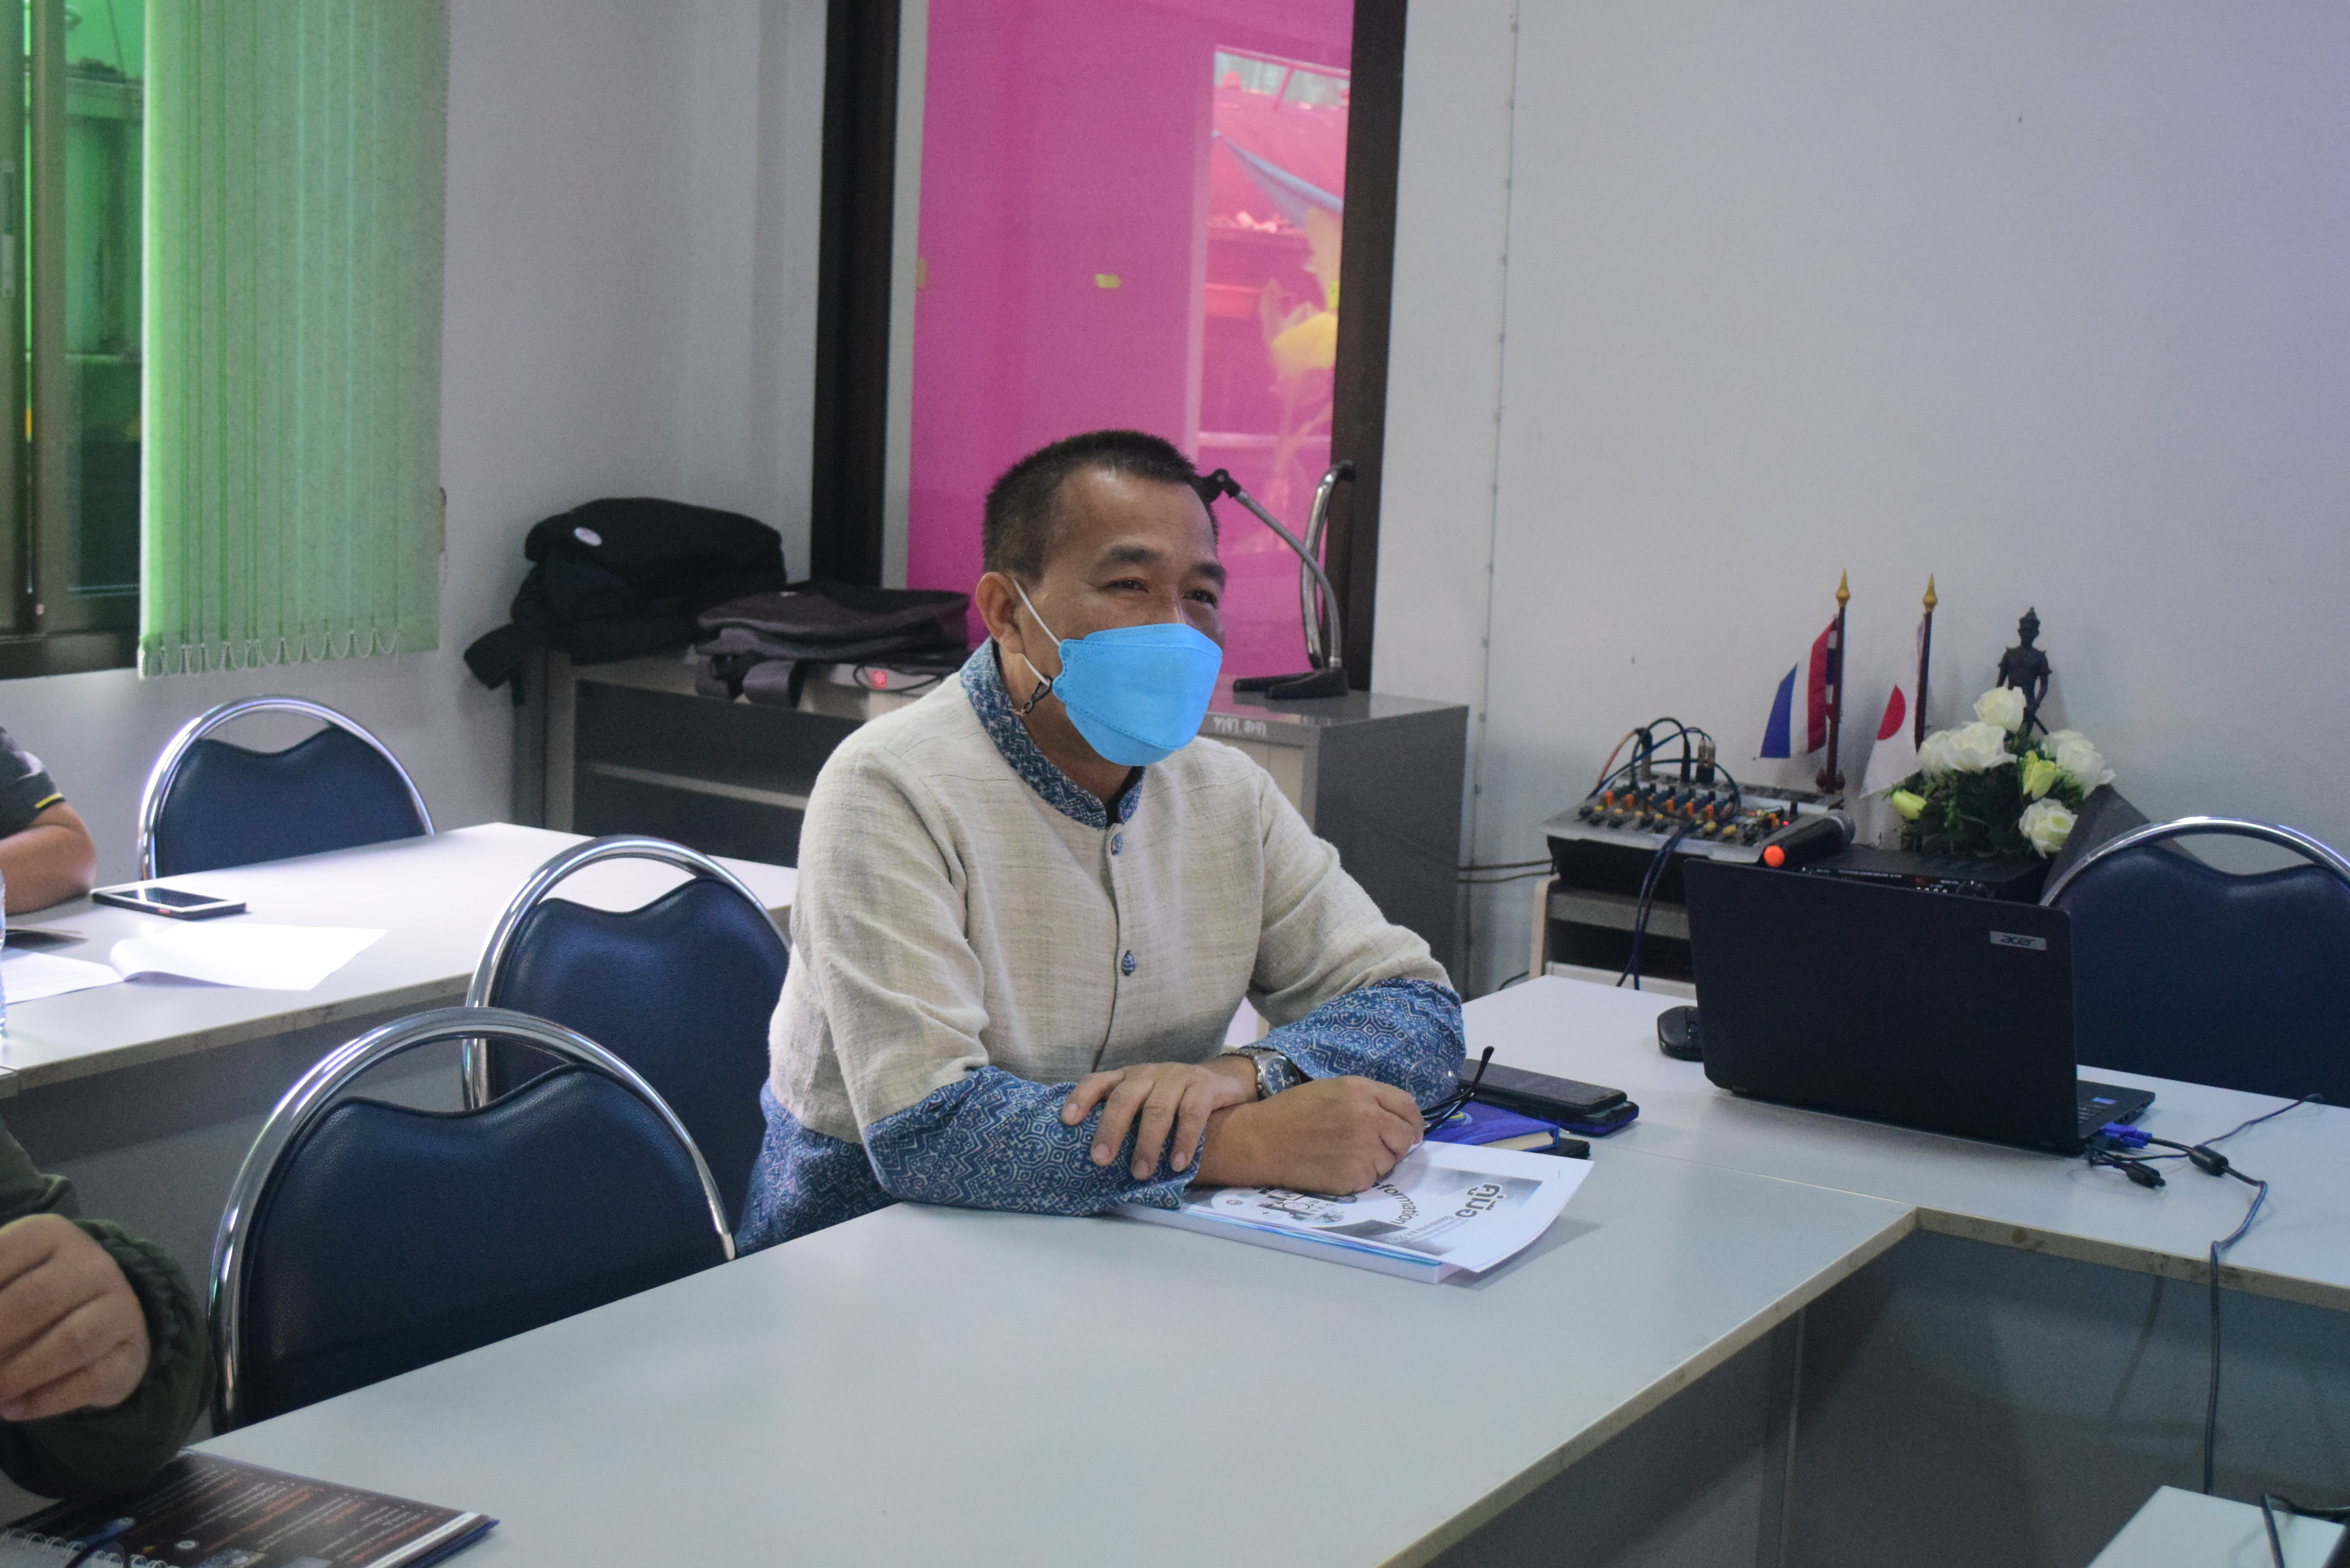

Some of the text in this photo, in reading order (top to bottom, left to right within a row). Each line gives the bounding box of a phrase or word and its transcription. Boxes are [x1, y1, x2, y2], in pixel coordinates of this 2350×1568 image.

[2000, 935, 2035, 947] acer
[1455, 1183, 1505, 1218] คู่มือ
